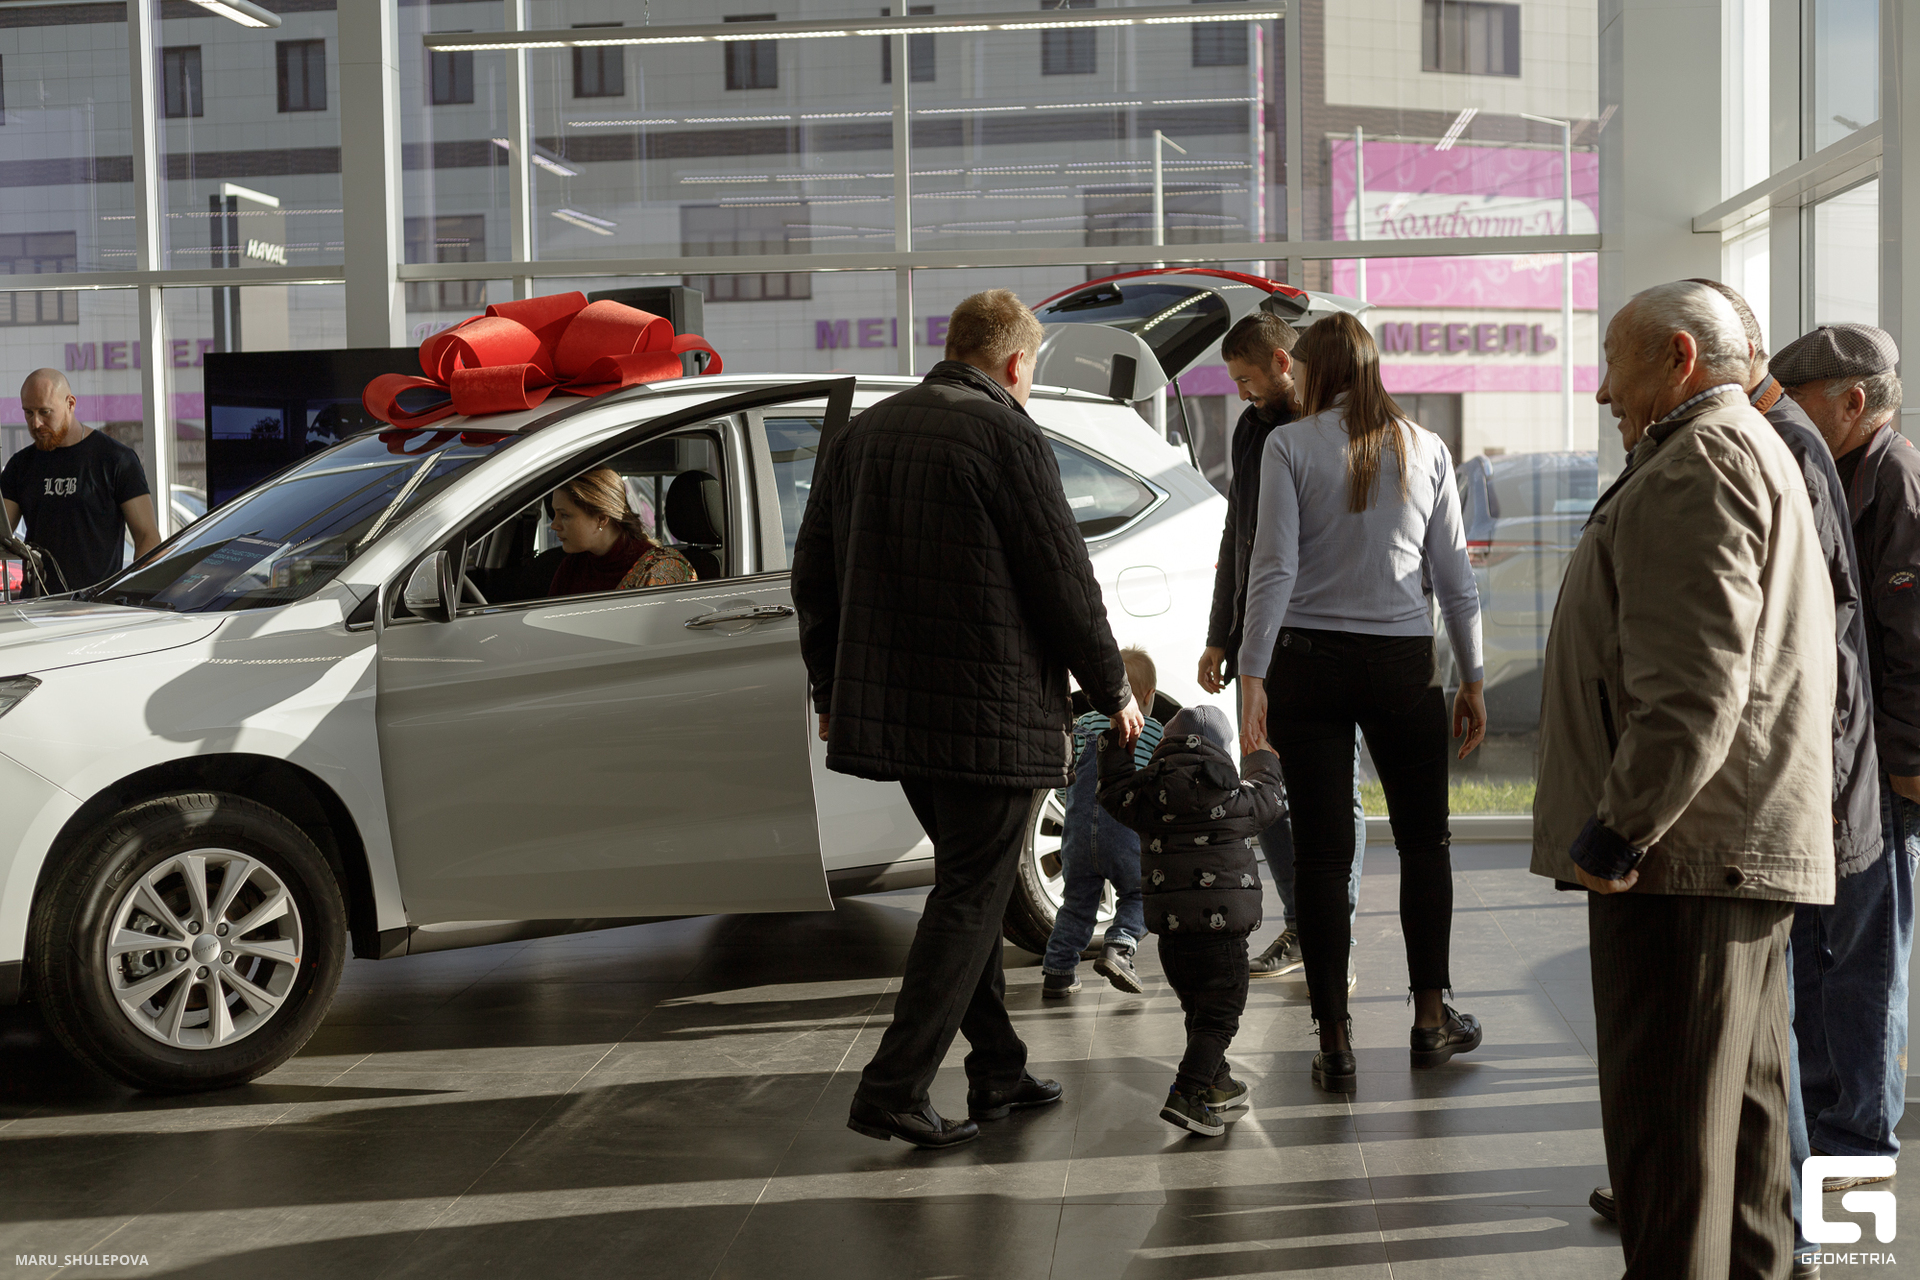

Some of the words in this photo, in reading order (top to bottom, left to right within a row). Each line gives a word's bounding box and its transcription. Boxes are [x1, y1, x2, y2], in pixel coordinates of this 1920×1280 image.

[247, 239, 288, 266] HAVAL
[815, 316, 950, 350] МЕЕ
[1383, 321, 1557, 353] МЕБЕЛЬ
[43, 477, 77, 497] LTB
